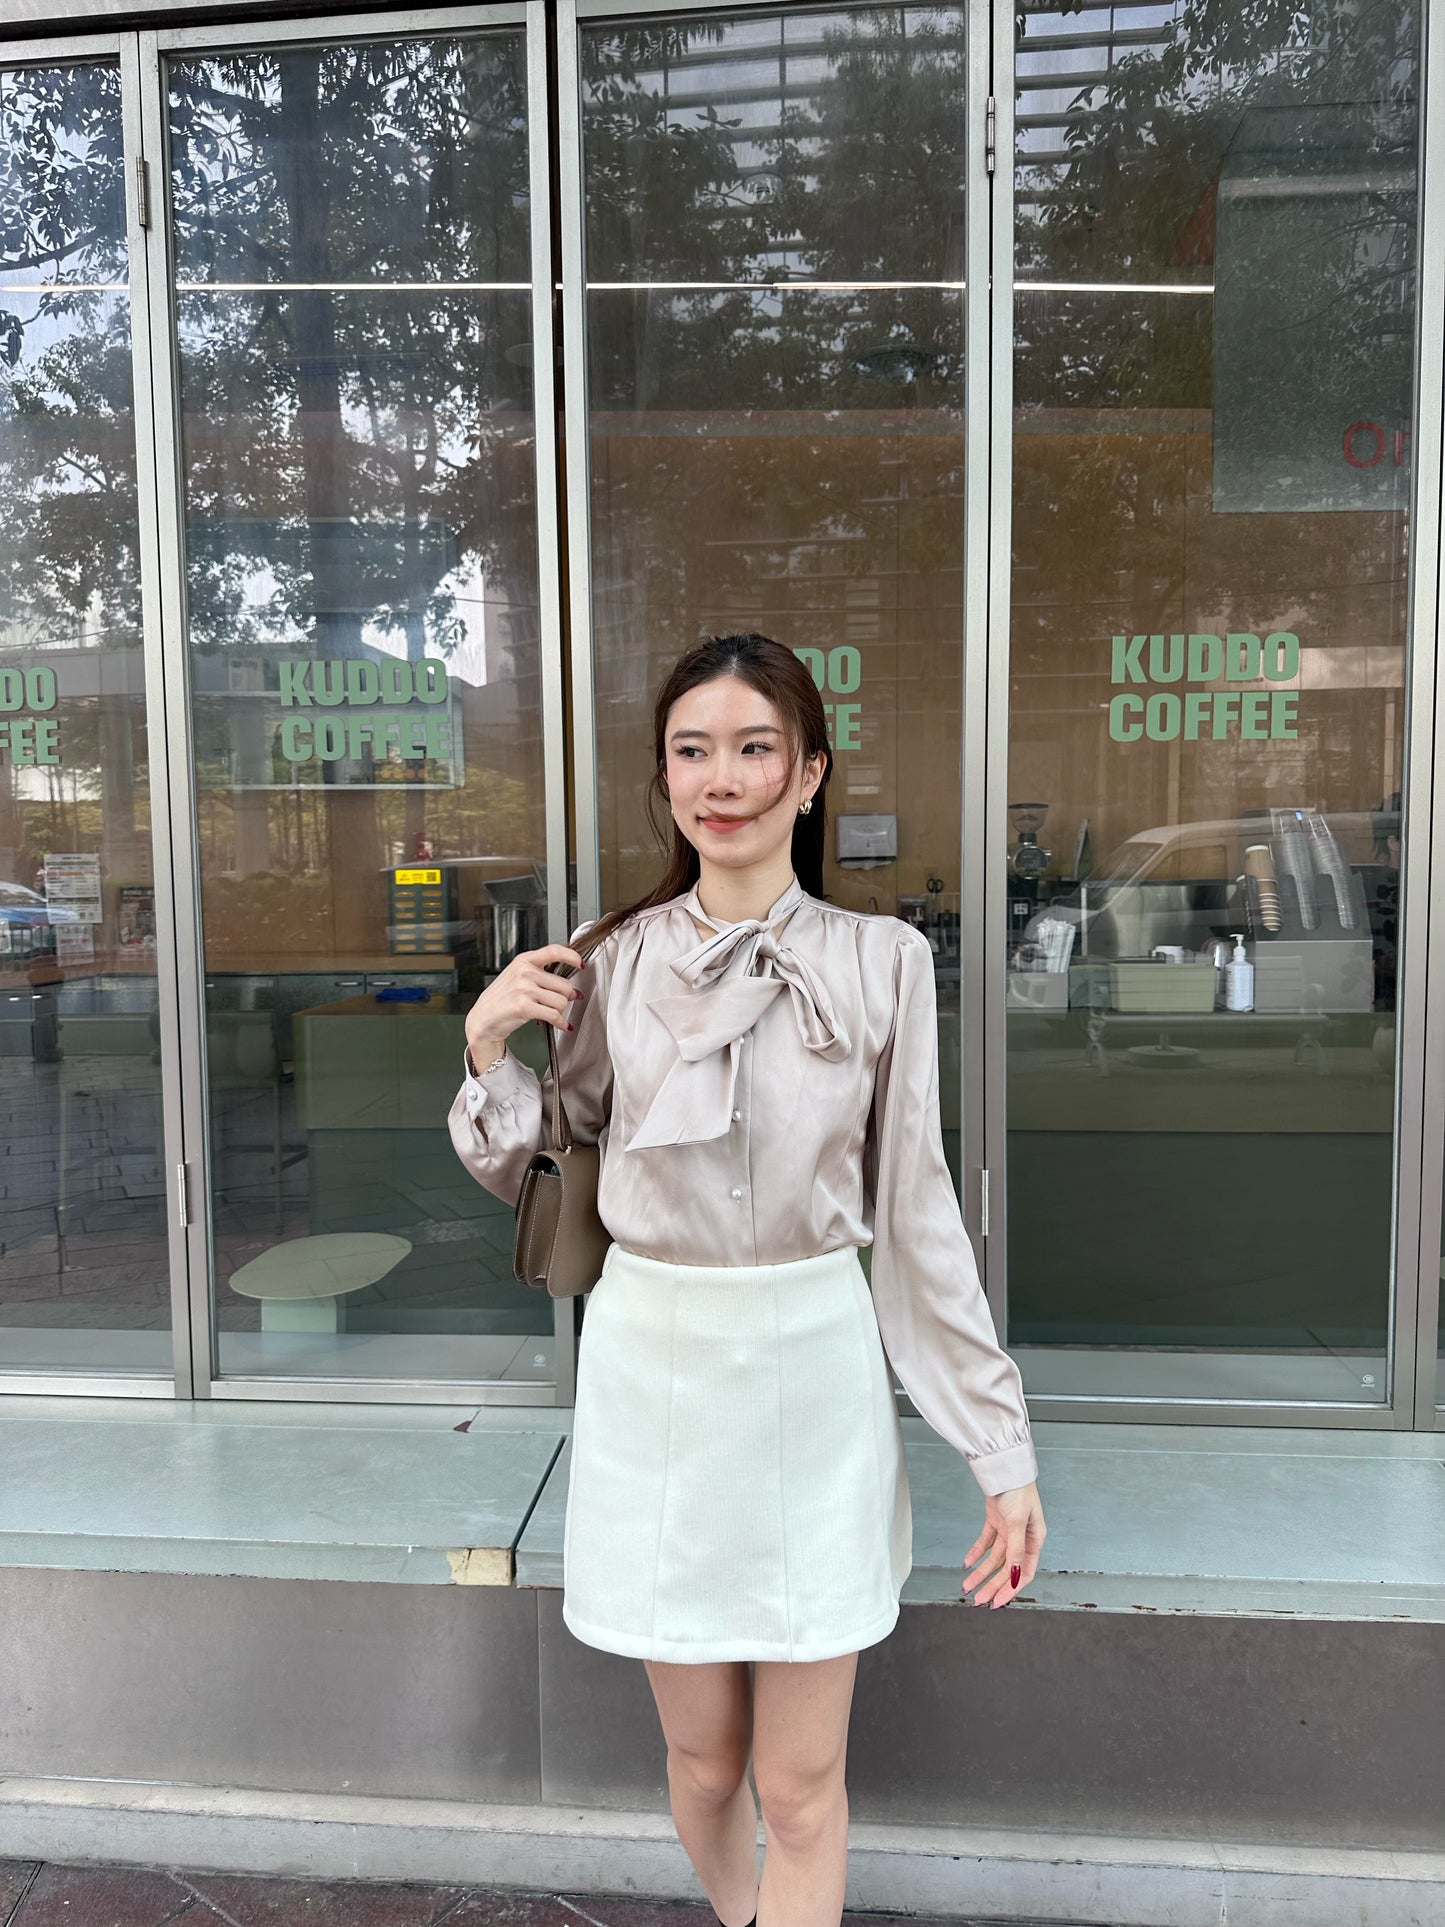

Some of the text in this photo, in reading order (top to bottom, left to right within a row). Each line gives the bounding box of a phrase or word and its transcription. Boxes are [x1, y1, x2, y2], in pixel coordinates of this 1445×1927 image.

[279, 658, 447, 706] KUDDO
[1111, 632, 1299, 683] KUDDO
[281, 714, 450, 761] COFFEE
[1109, 691, 1299, 742] COFFEE
